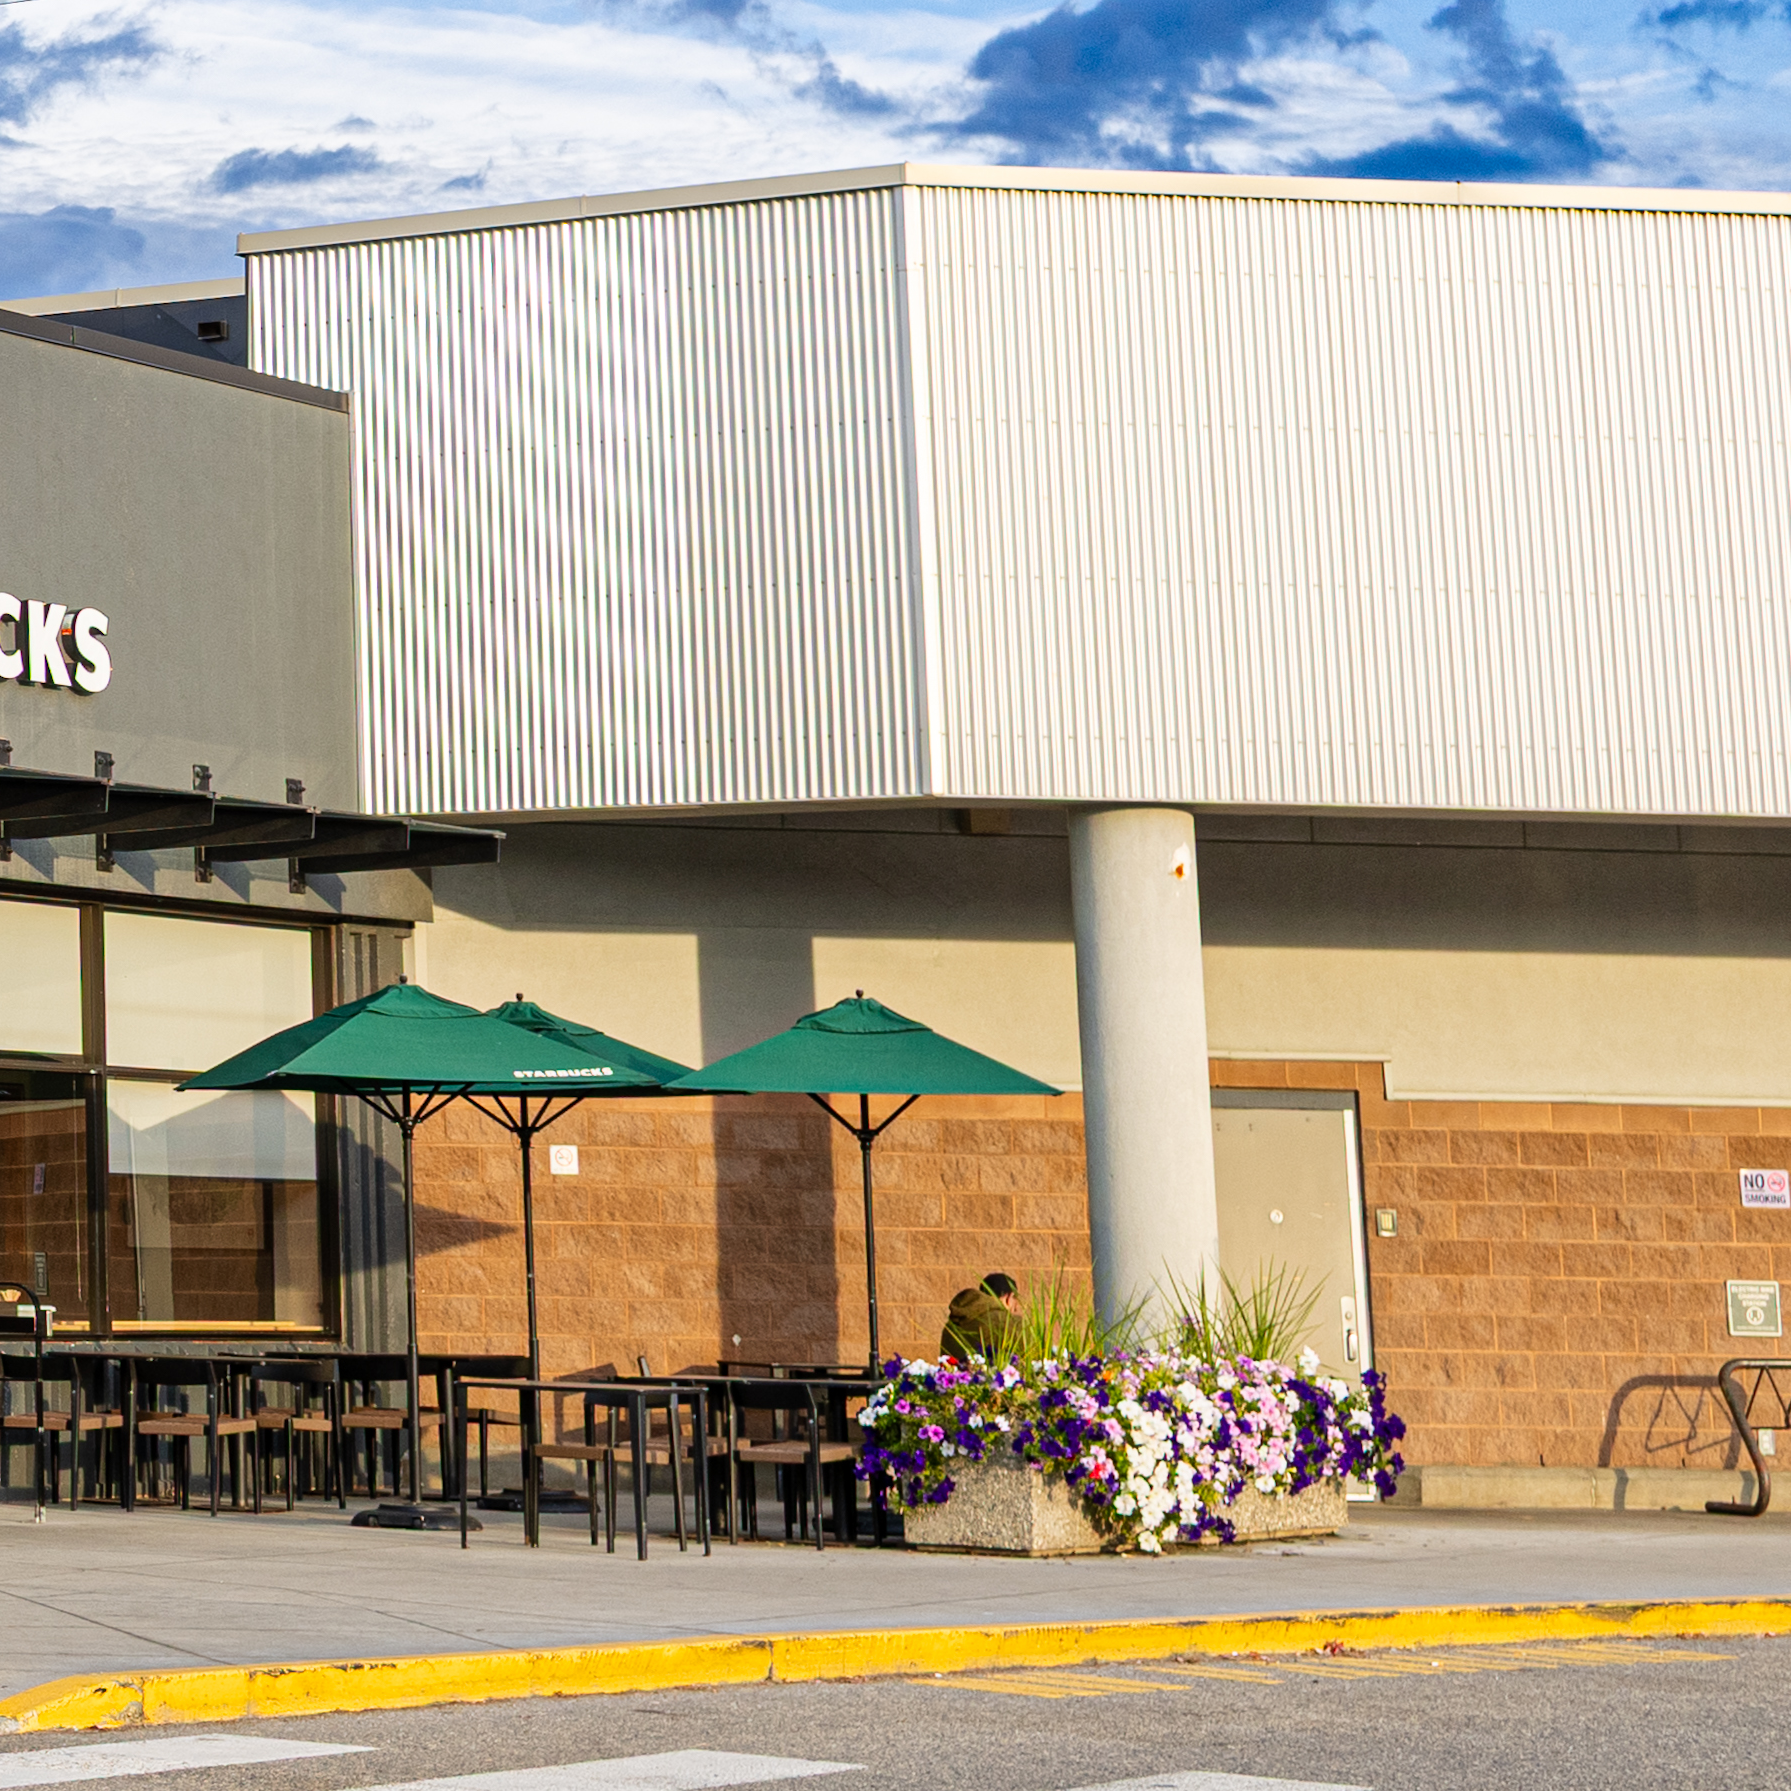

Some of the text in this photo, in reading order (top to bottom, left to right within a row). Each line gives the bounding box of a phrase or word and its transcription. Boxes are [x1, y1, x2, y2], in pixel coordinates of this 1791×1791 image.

[513, 1067, 614, 1078] STARBUCKS
[1743, 1173, 1766, 1190] NO
[1744, 1193, 1787, 1205] SMOKING
